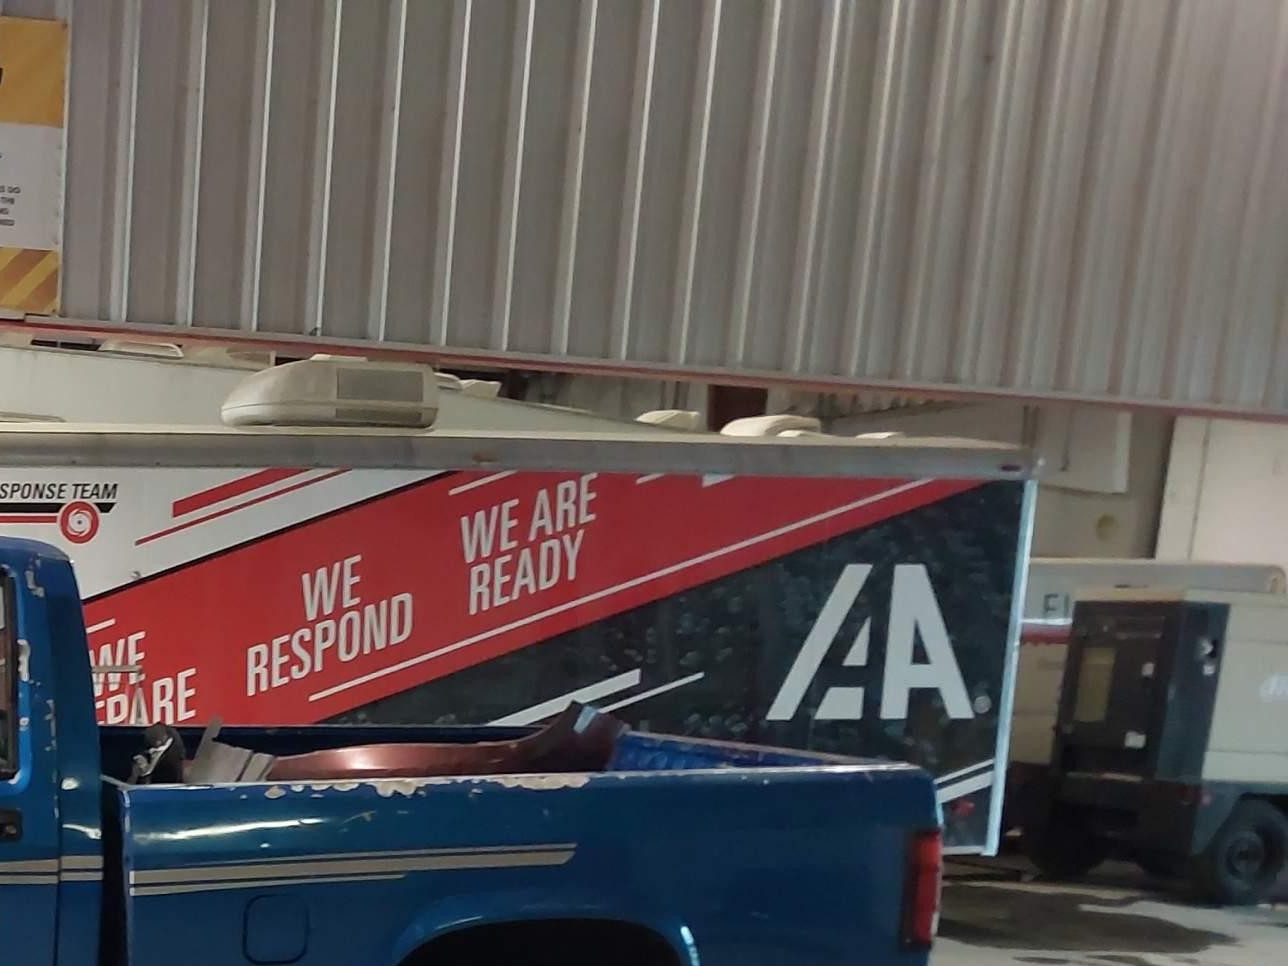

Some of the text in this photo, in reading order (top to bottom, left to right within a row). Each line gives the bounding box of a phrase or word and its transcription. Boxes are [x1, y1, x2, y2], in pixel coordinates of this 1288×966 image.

[72, 483, 118, 500] TEAM
[460, 472, 598, 564] WE ARE
[301, 554, 362, 621] WE
[469, 529, 584, 616] READY
[89, 631, 145, 697] WE
[246, 592, 412, 696] RESPOND
